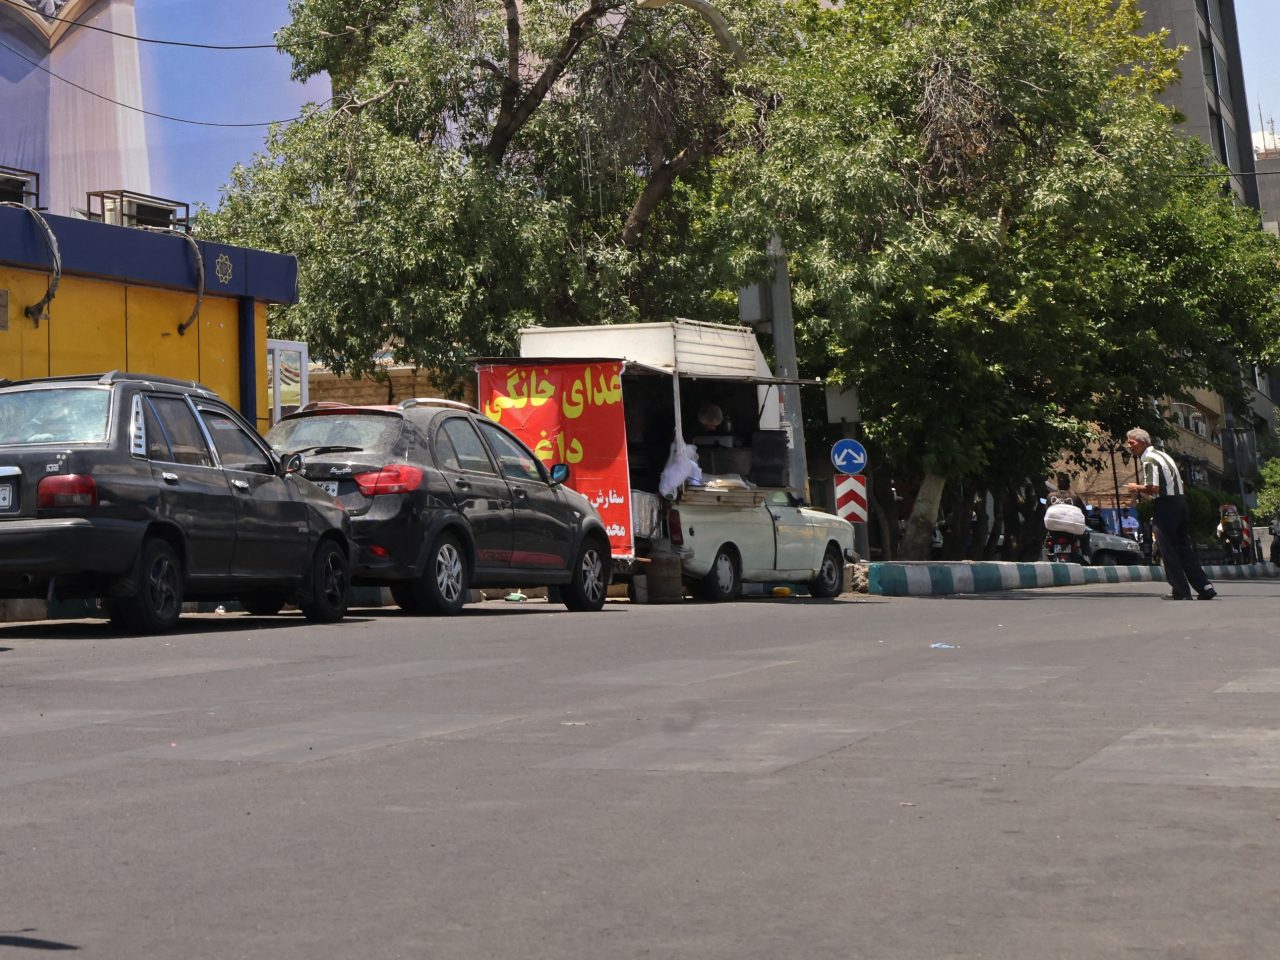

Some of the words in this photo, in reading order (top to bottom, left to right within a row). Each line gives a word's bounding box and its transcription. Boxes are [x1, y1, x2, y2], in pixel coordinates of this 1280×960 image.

[485, 368, 555, 423] خانگی
[562, 365, 623, 419] غذای
[590, 489, 625, 508] سفارش
